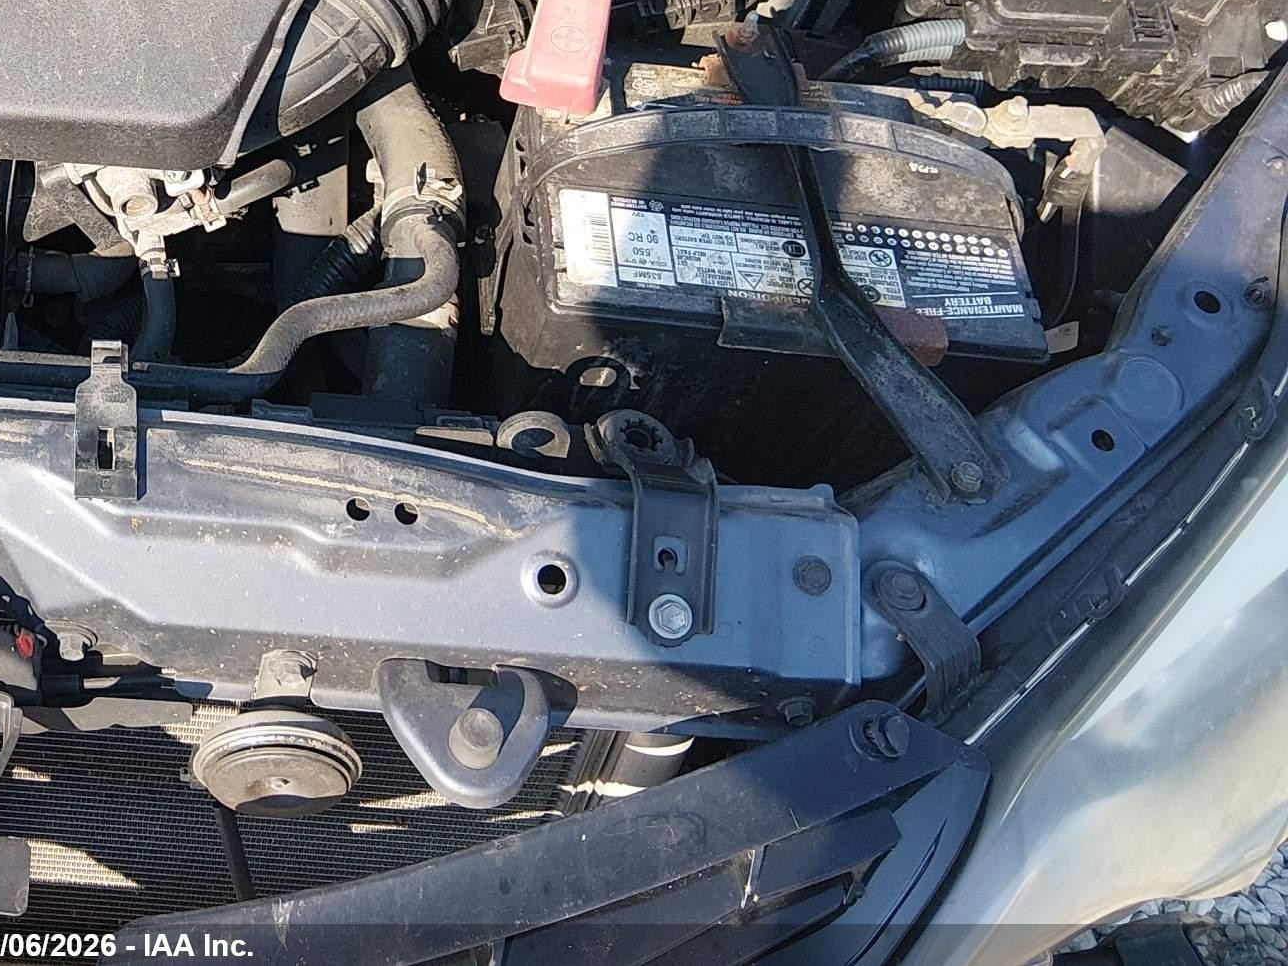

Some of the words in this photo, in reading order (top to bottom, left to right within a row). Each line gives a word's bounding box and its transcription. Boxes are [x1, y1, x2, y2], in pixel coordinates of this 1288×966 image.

[627, 231, 643, 242] RC
[646, 233, 658, 243] 90
[943, 296, 991, 305] BATTERY
[914, 304, 1023, 314] MAINTENANCE-FREE
